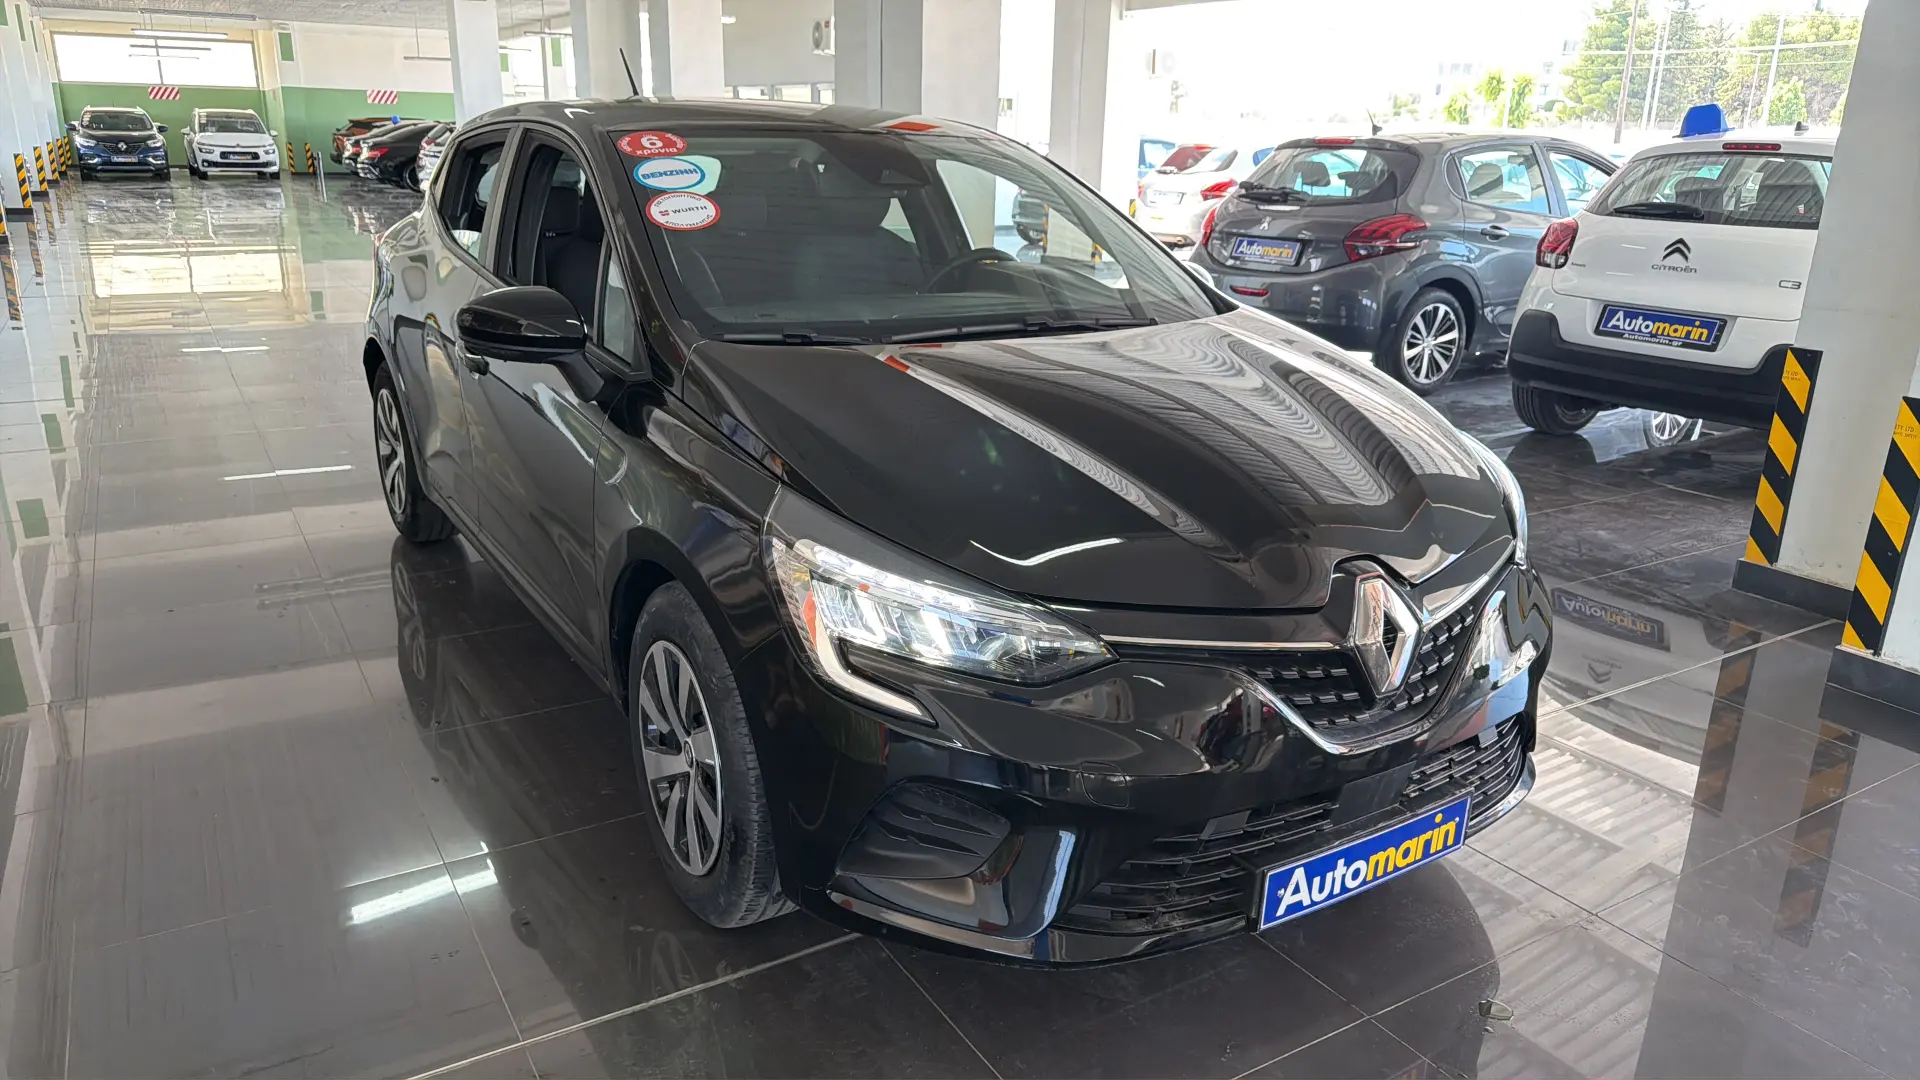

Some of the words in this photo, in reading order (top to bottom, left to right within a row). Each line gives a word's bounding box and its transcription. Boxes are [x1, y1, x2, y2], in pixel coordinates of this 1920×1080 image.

[641, 136, 663, 149] 6
[1237, 240, 1293, 258] Automarin
[1778, 279, 1802, 290] C3
[1606, 310, 1709, 341] Automarin
[1275, 812, 1458, 917] Automarin
